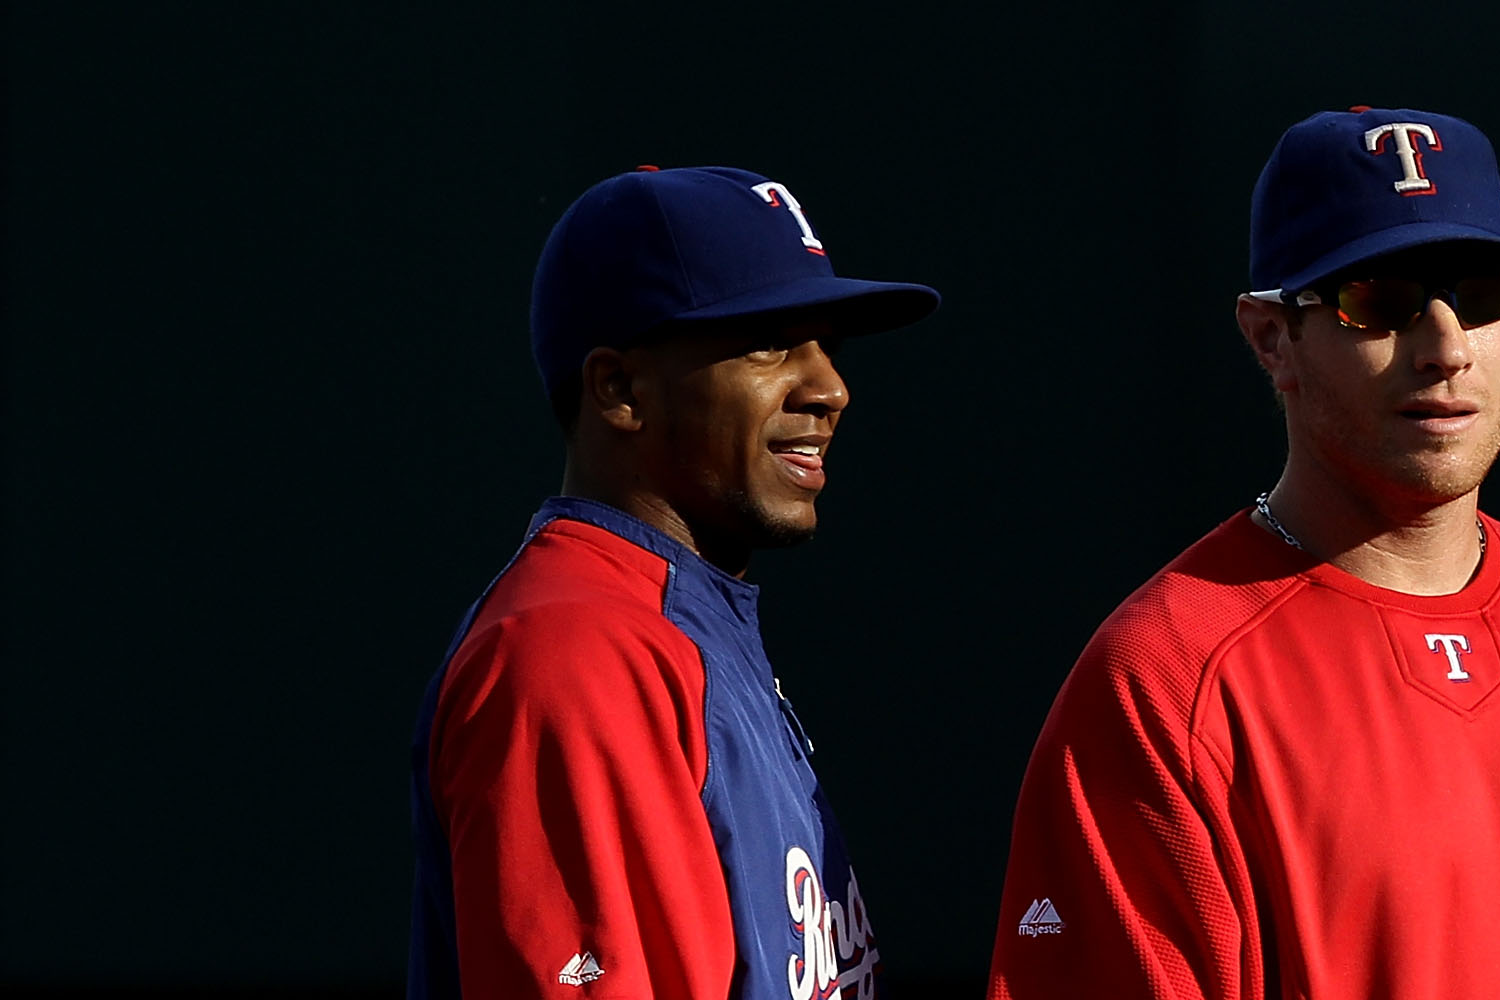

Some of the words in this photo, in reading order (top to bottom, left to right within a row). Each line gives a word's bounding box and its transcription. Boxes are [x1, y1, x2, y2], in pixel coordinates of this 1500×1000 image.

[1364, 122, 1443, 197] T
[751, 180, 826, 257] T
[1424, 633, 1472, 683] T
